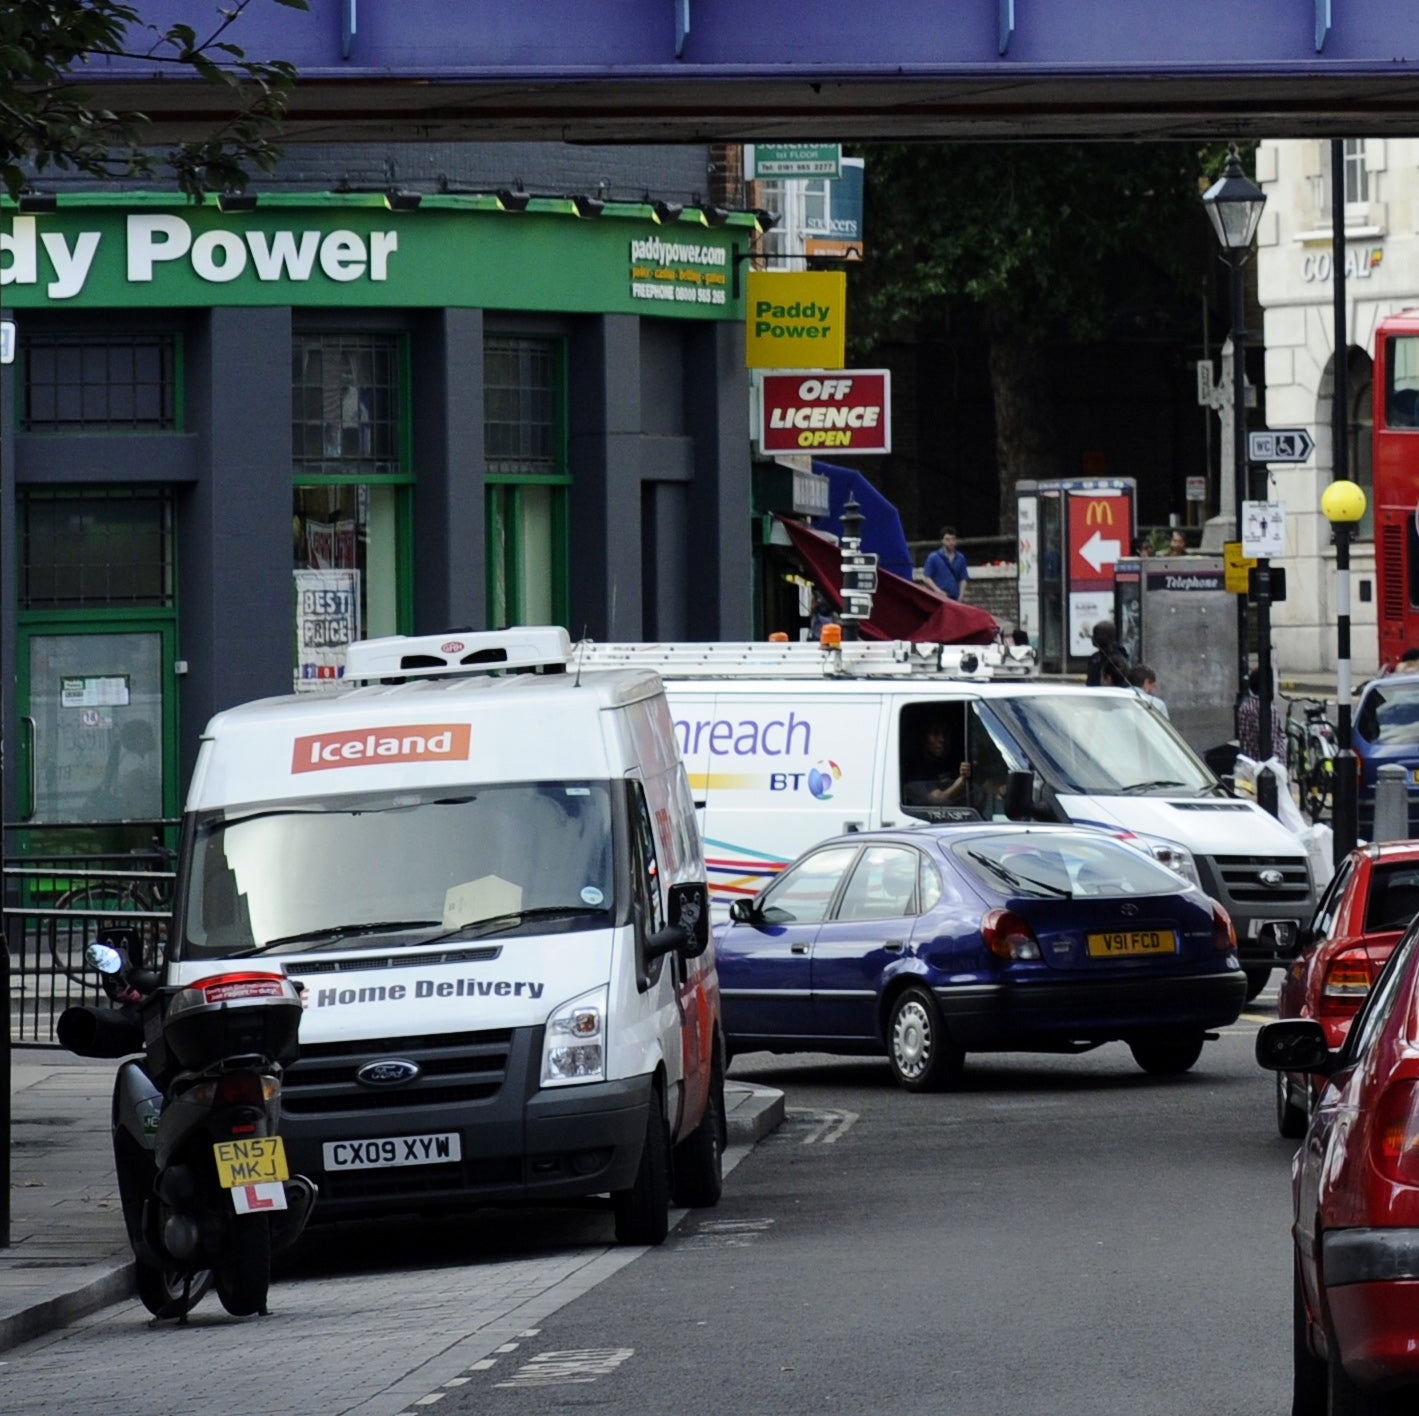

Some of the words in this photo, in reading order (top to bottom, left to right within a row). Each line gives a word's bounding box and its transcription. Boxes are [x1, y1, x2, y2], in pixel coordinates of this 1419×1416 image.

[790, 151, 818, 159] FLOOR
[127, 214, 399, 283] Power
[631, 236, 726, 266] paddypower.com
[1302, 247, 1372, 283] COAL
[632, 283, 675, 301] FREEPHONE
[756, 301, 830, 322] Paddy
[755, 321, 831, 338] Power
[799, 379, 853, 401] OFF
[769, 406, 880, 429] LICENCE
[797, 431, 851, 447] OPEN
[1256, 440, 1272, 454] WC
[1165, 575, 1218, 589] Telephone
[303, 590, 348, 615] BEST
[303, 620, 348, 646] PRICE
[665, 712, 811, 755] nreach
[311, 731, 452, 764] Iceland
[770, 773, 805, 791] BT
[1131, 933, 1160, 949] FCD
[318, 983, 406, 1008] Home
[415, 979, 545, 1000] Delivery
[371, 1065, 404, 1080] Ford
[219, 1139, 278, 1162] EN57
[333, 1139, 396, 1165] CX09
[403, 1135, 450, 1162] XYW
[231, 1159, 277, 1181] MKJ
[245, 1185, 274, 1209] L
